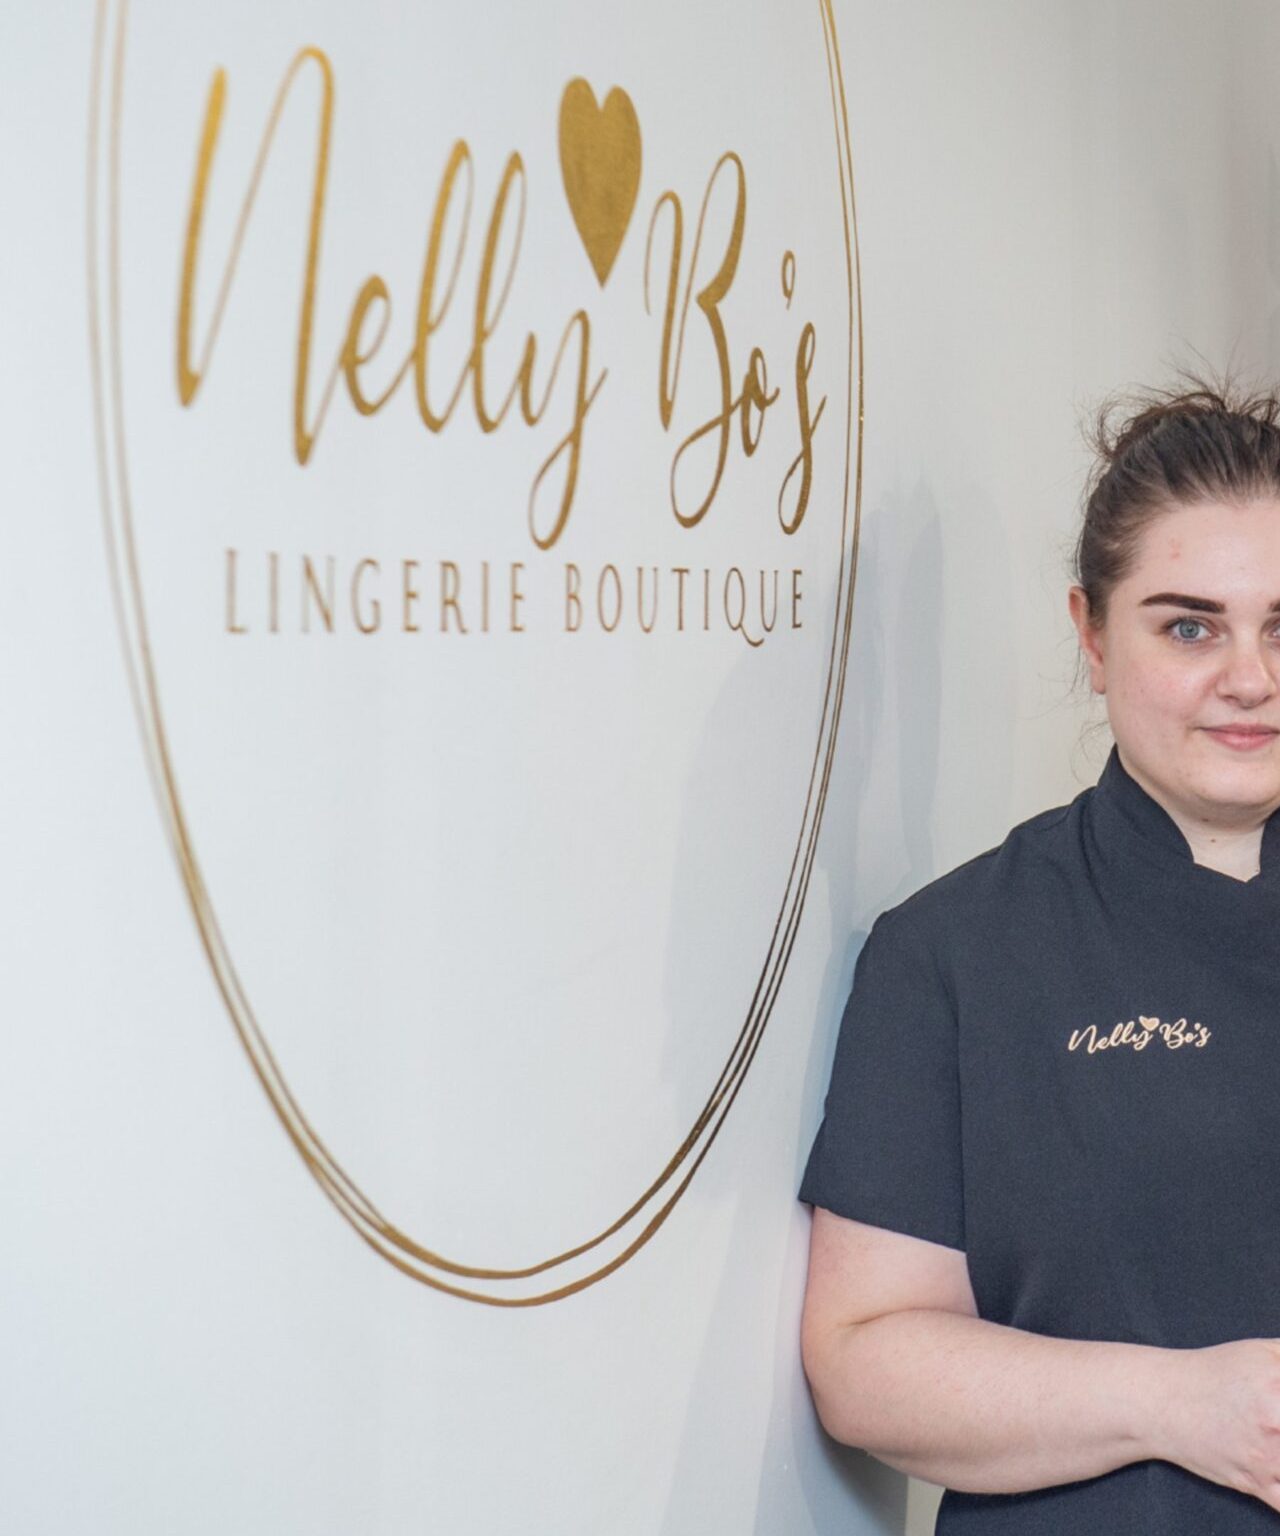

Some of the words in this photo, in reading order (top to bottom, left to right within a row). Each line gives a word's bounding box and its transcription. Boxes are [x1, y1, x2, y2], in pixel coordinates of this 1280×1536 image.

[175, 46, 607, 551] Nelly
[645, 150, 828, 537] Bo's
[225, 548, 526, 634] LINGERIE
[564, 562, 803, 648] BOUTIQUE
[1068, 1021, 1154, 1054] Nelly
[1159, 1018, 1211, 1050] Bo's
